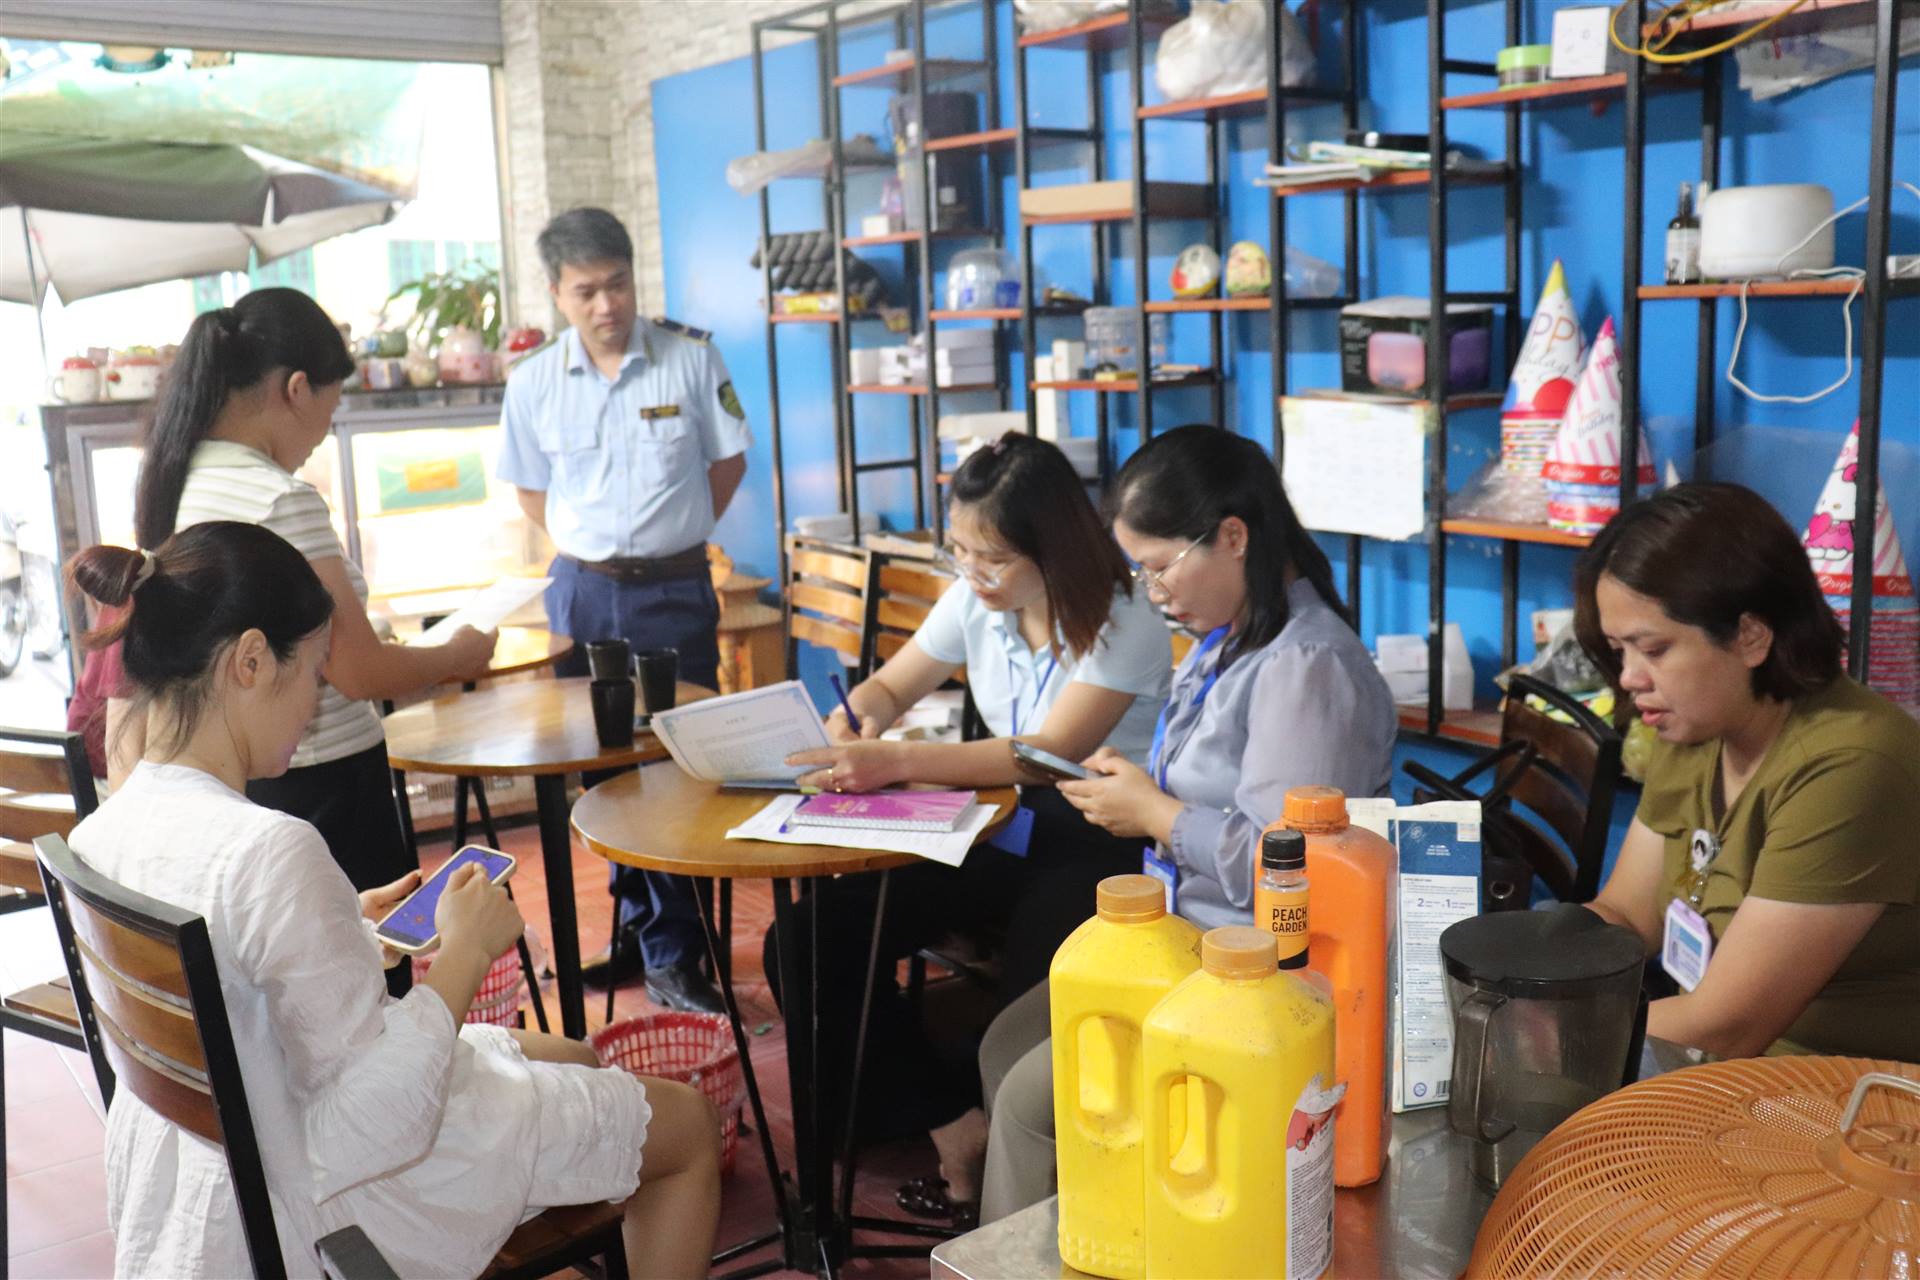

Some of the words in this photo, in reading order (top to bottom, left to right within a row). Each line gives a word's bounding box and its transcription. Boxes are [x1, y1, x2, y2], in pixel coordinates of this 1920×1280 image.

[1417, 897, 1425, 907] 2
[1272, 906, 1308, 921] PEACH
[1271, 920, 1308, 933] GARDEN
